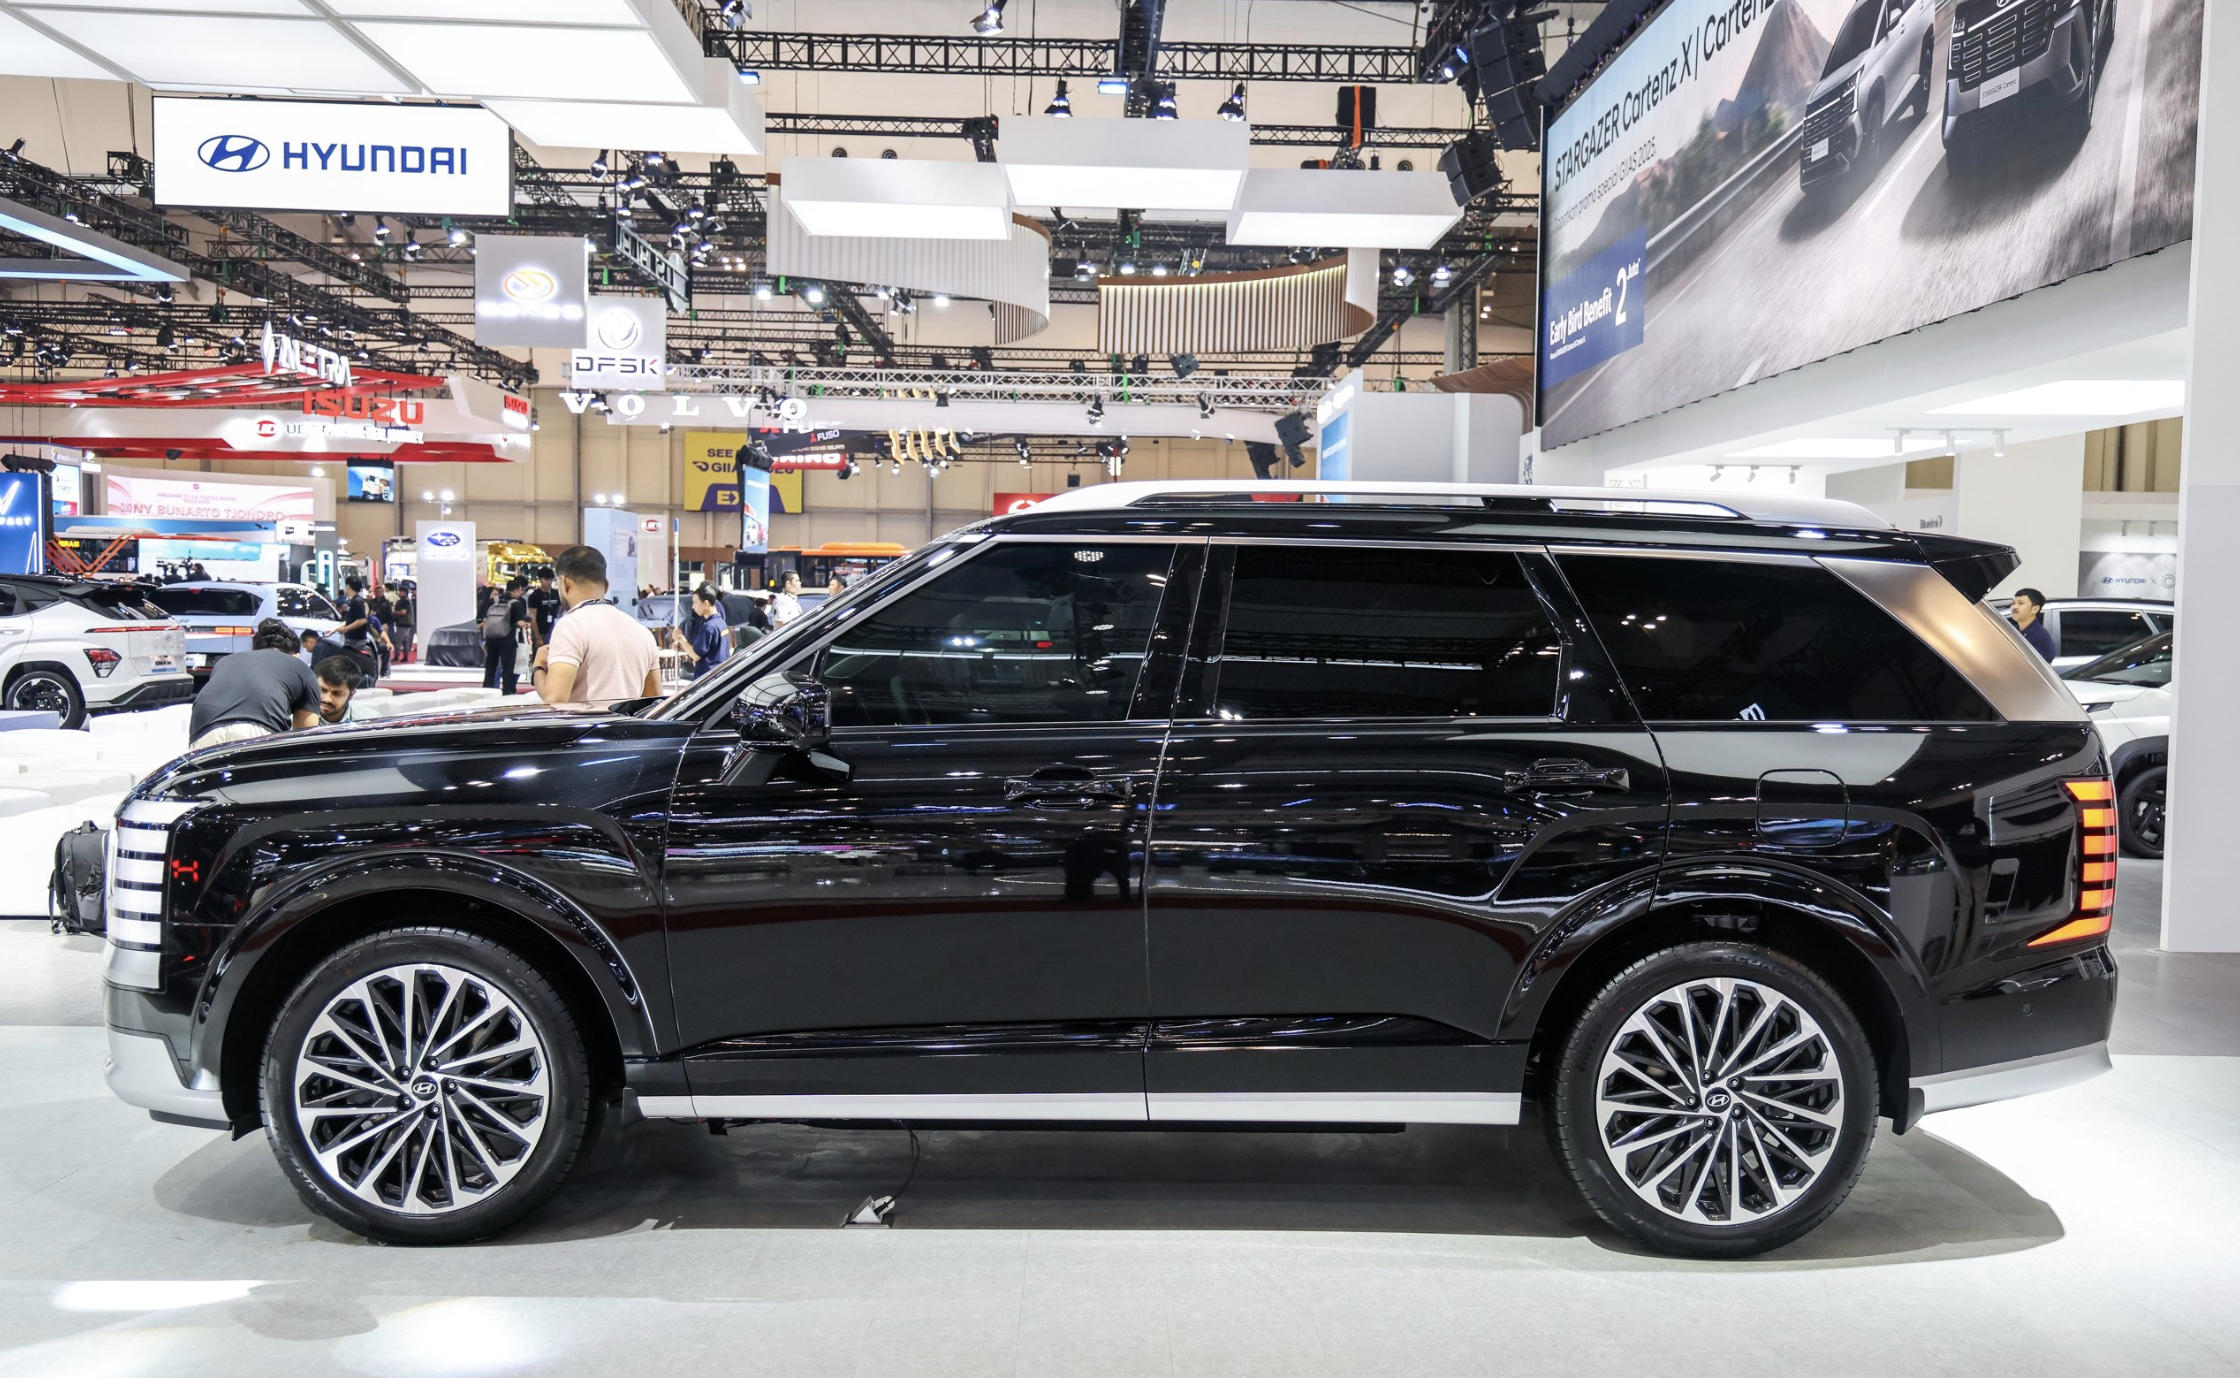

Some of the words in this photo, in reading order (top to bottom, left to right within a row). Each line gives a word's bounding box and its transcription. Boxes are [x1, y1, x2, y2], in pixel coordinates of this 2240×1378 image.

[1555, 103, 1620, 192] STARGAZER
[1622, 57, 1678, 131] Cartenz
[1680, 34, 1693, 85] X
[1703, 0, 1776, 62] Carten
[283, 141, 468, 175] HYUNDAI
[1615, 266, 1628, 327] 2
[1549, 314, 1568, 346] Early
[1568, 303, 1583, 336] Bird
[1583, 286, 1613, 327] Benefit
[575, 356, 659, 375] DFSK
[303, 390, 424, 425] ISUZU
[559, 392, 808, 419] VOLVO
[817, 429, 840, 441] FUSO
[707, 448, 733, 458] SEE
[157, 505, 220, 518] BUNARTO
[223, 508, 285, 522] TJONDRO
